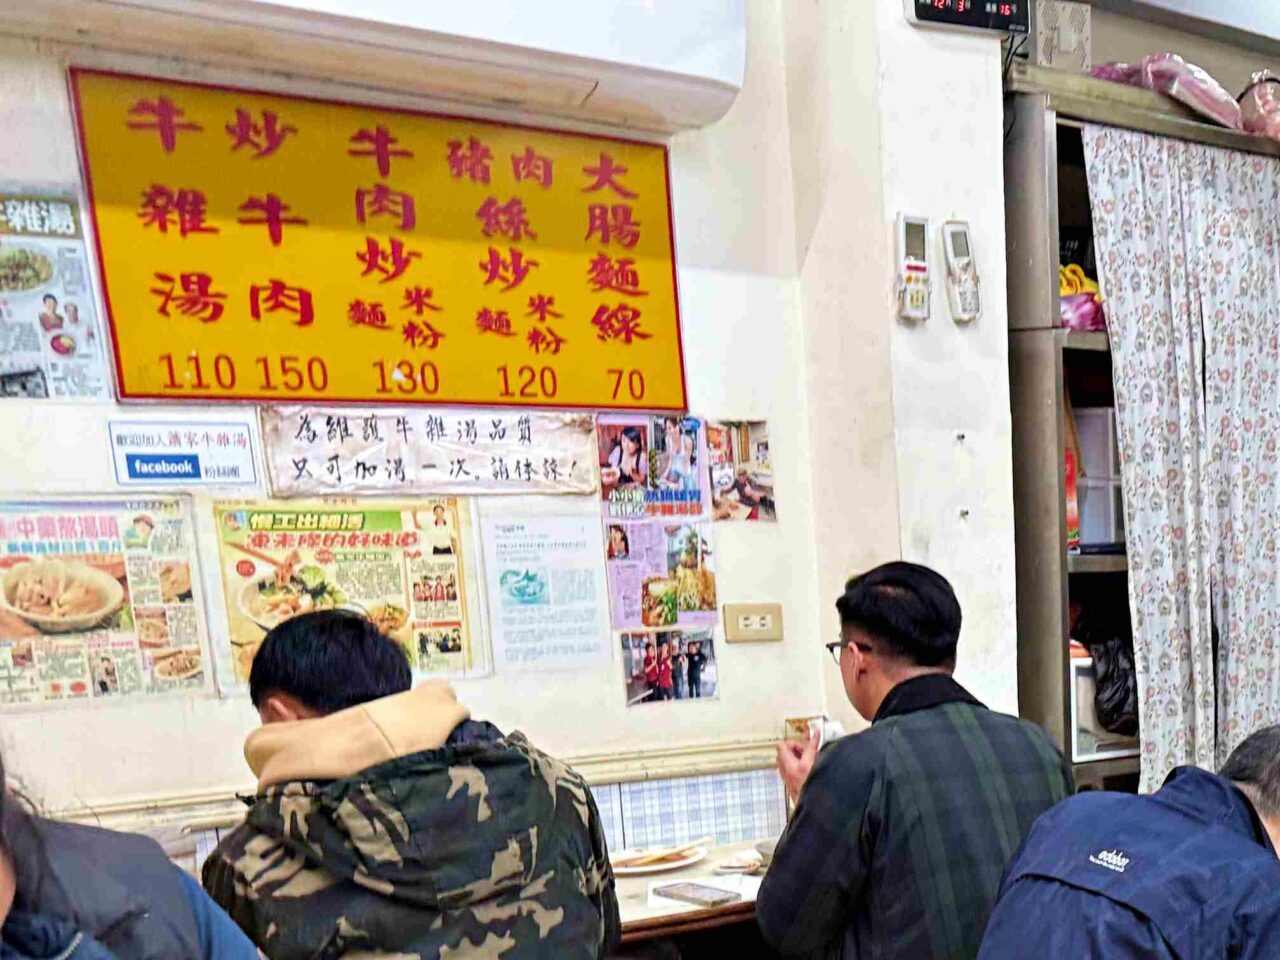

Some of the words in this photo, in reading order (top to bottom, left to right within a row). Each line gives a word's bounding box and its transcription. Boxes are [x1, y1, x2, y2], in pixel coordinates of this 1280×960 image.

[225, 107, 315, 326] 炒牛肉
[158, 354, 237, 391] 110
[255, 356, 329, 393] 150
[372, 359, 441, 395] 130
[496, 364, 558, 399] 120
[607, 369, 646, 401] 70
[134, 459, 194, 475] facebook
